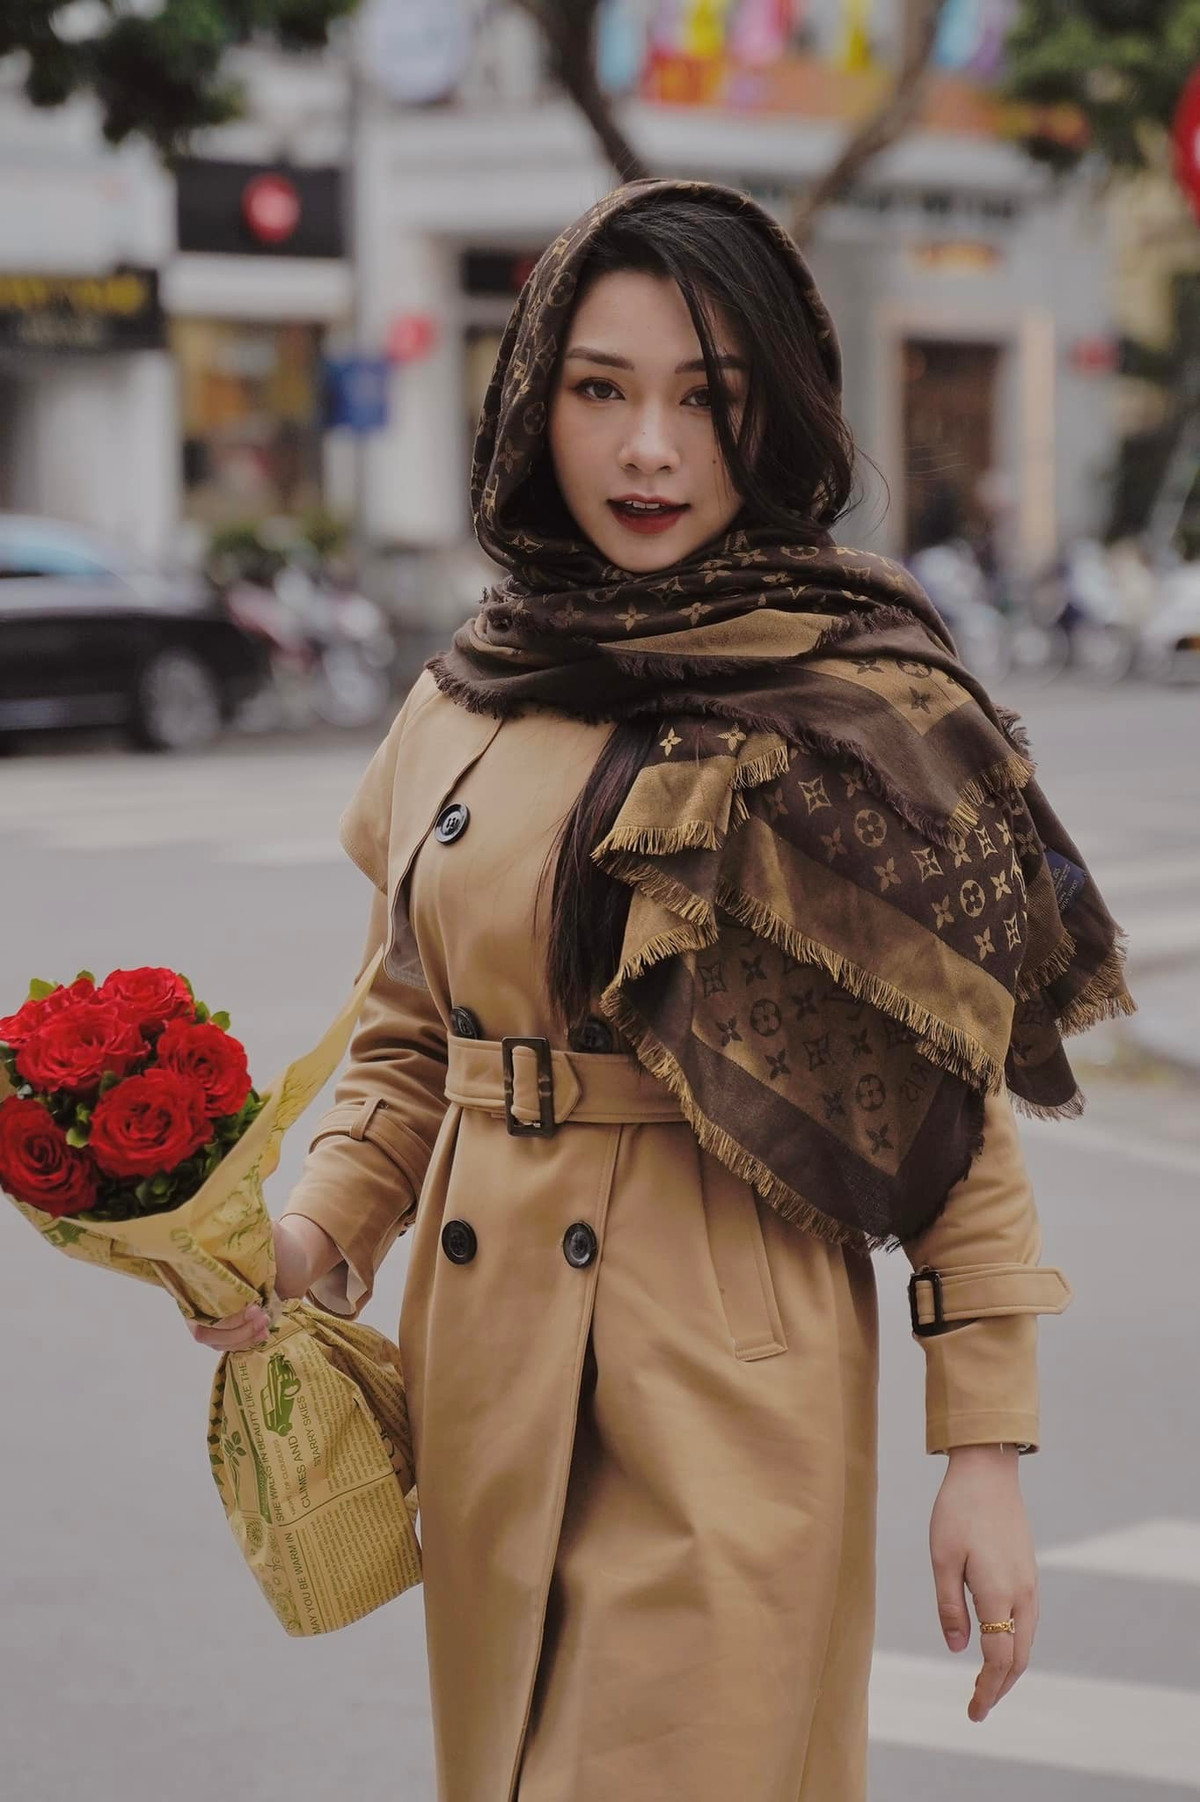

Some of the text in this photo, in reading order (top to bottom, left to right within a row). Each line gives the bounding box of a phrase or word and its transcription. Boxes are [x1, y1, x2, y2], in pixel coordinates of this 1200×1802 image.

[238, 1359, 285, 1522] SHE WALKS IN BEAUTY LIKE THE
[288, 1435, 311, 1509] CLIMES AND
[296, 1395, 321, 1467] STARRY SKIES
[284, 1532, 322, 1635] MAY YOU BE WARM IN
